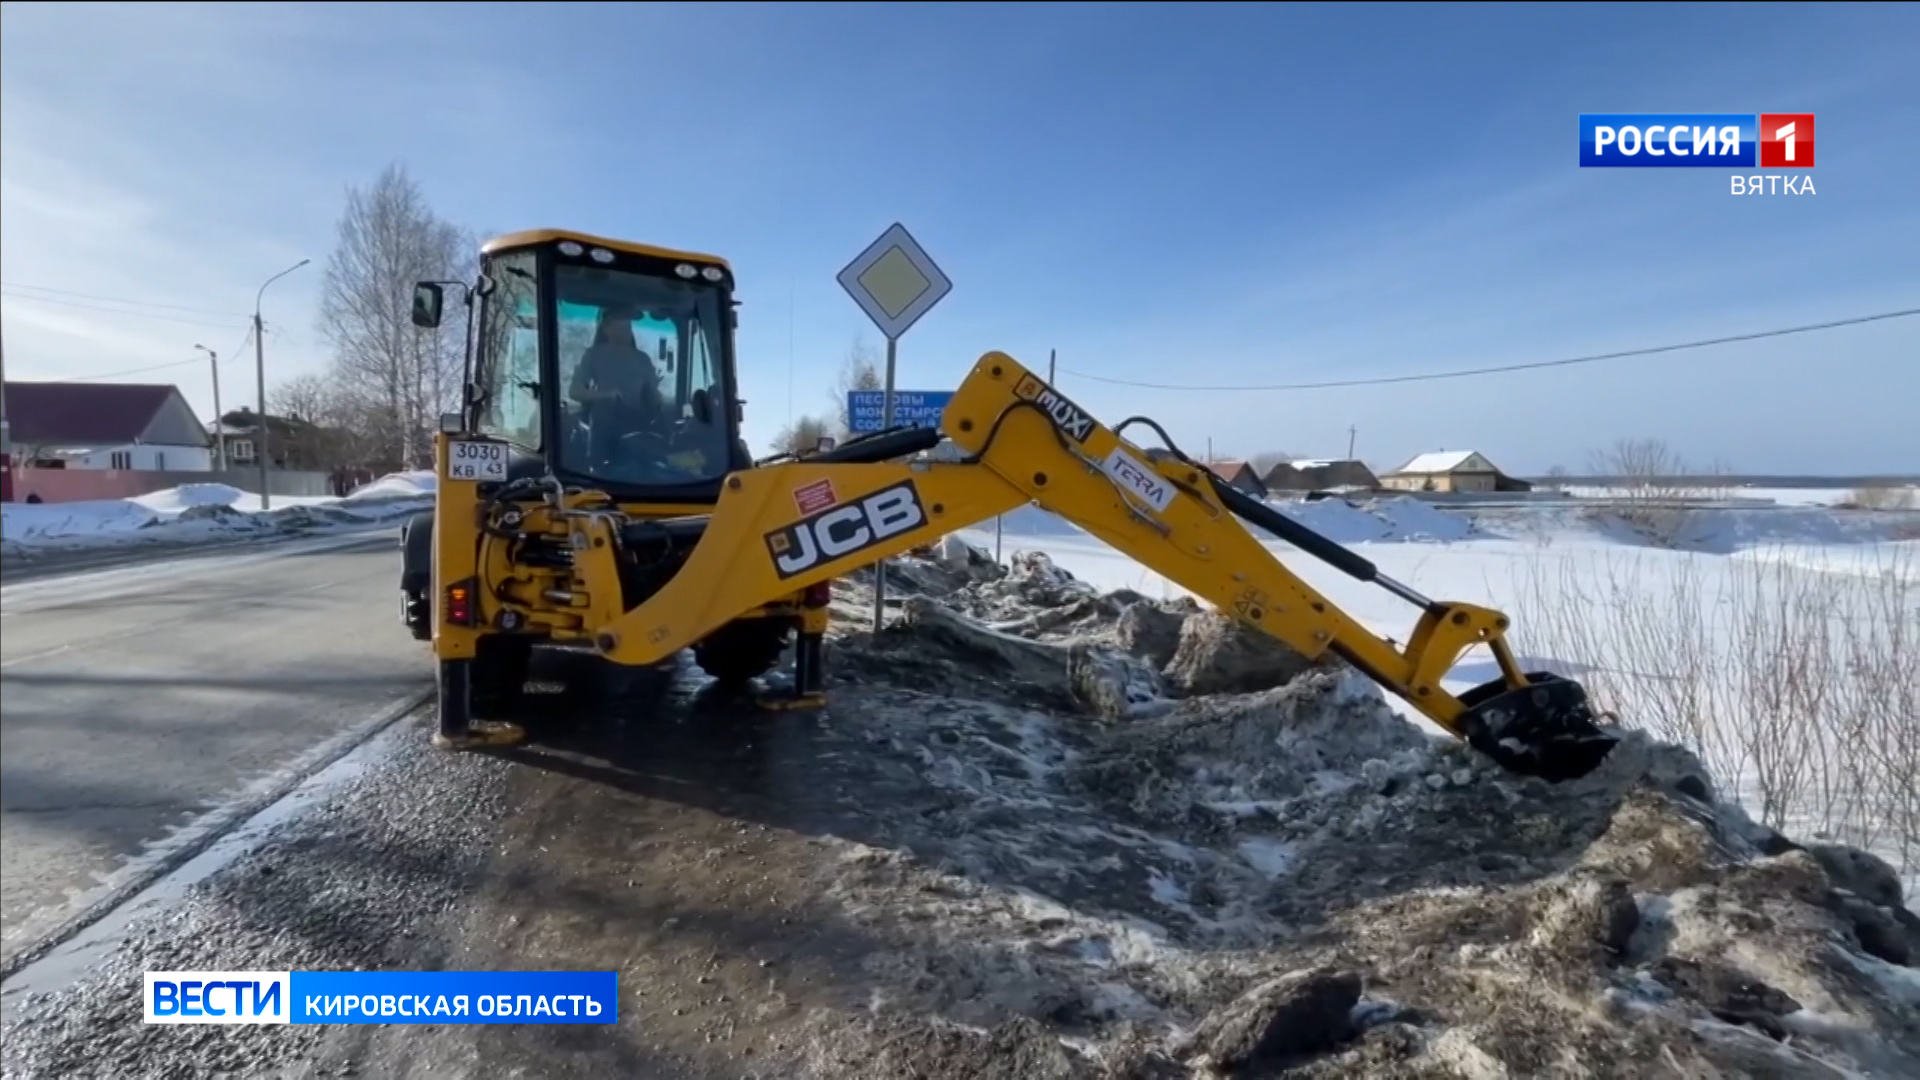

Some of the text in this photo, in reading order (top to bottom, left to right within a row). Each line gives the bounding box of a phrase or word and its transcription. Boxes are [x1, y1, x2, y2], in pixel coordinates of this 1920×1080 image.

[456, 443, 500, 460] 3030
[486, 463, 503, 474] 43
[1112, 455, 1164, 504] TERRA
[777, 486, 922, 573] JCB
